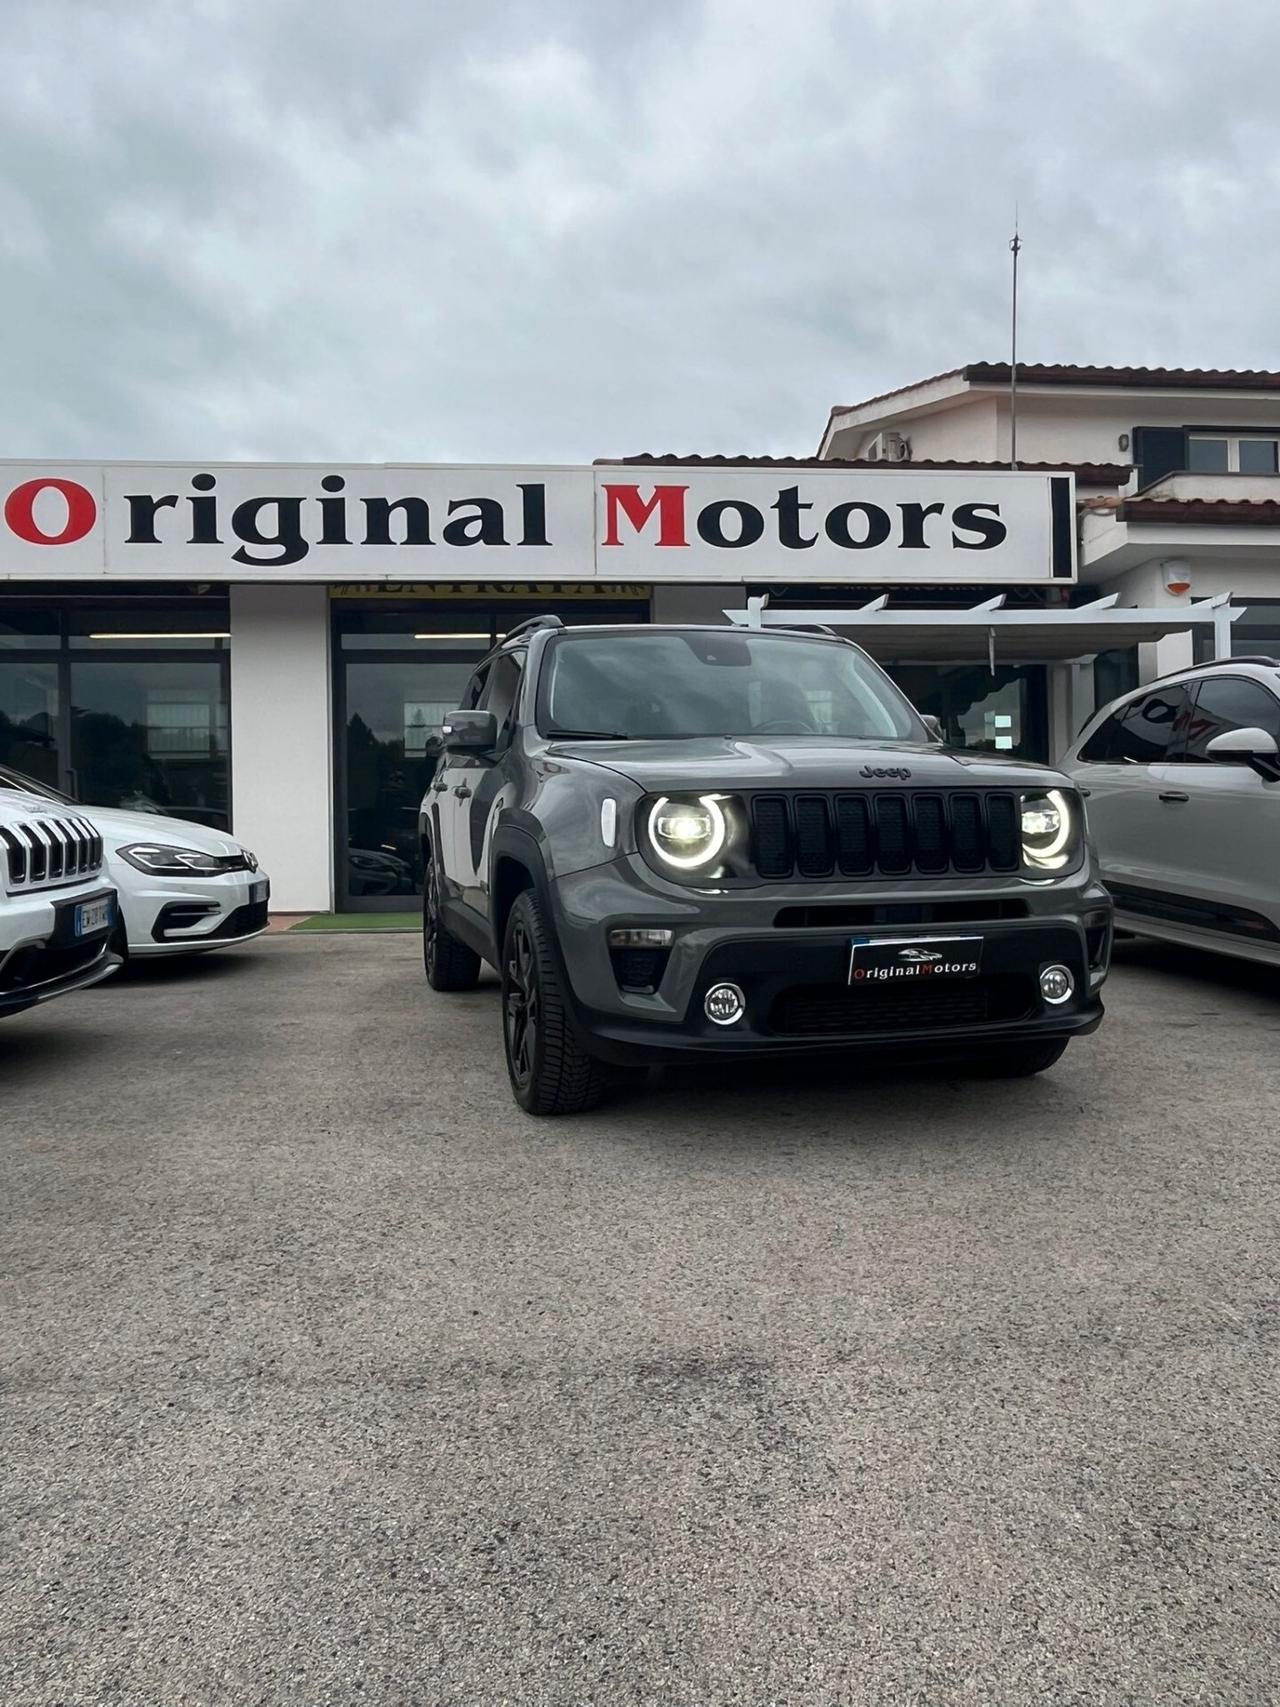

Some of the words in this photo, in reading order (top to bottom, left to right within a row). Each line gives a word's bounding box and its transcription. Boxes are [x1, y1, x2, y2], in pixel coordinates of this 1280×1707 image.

[4, 473, 553, 567] Original
[601, 484, 1008, 550] Motors
[859, 765, 912, 781] Jeep
